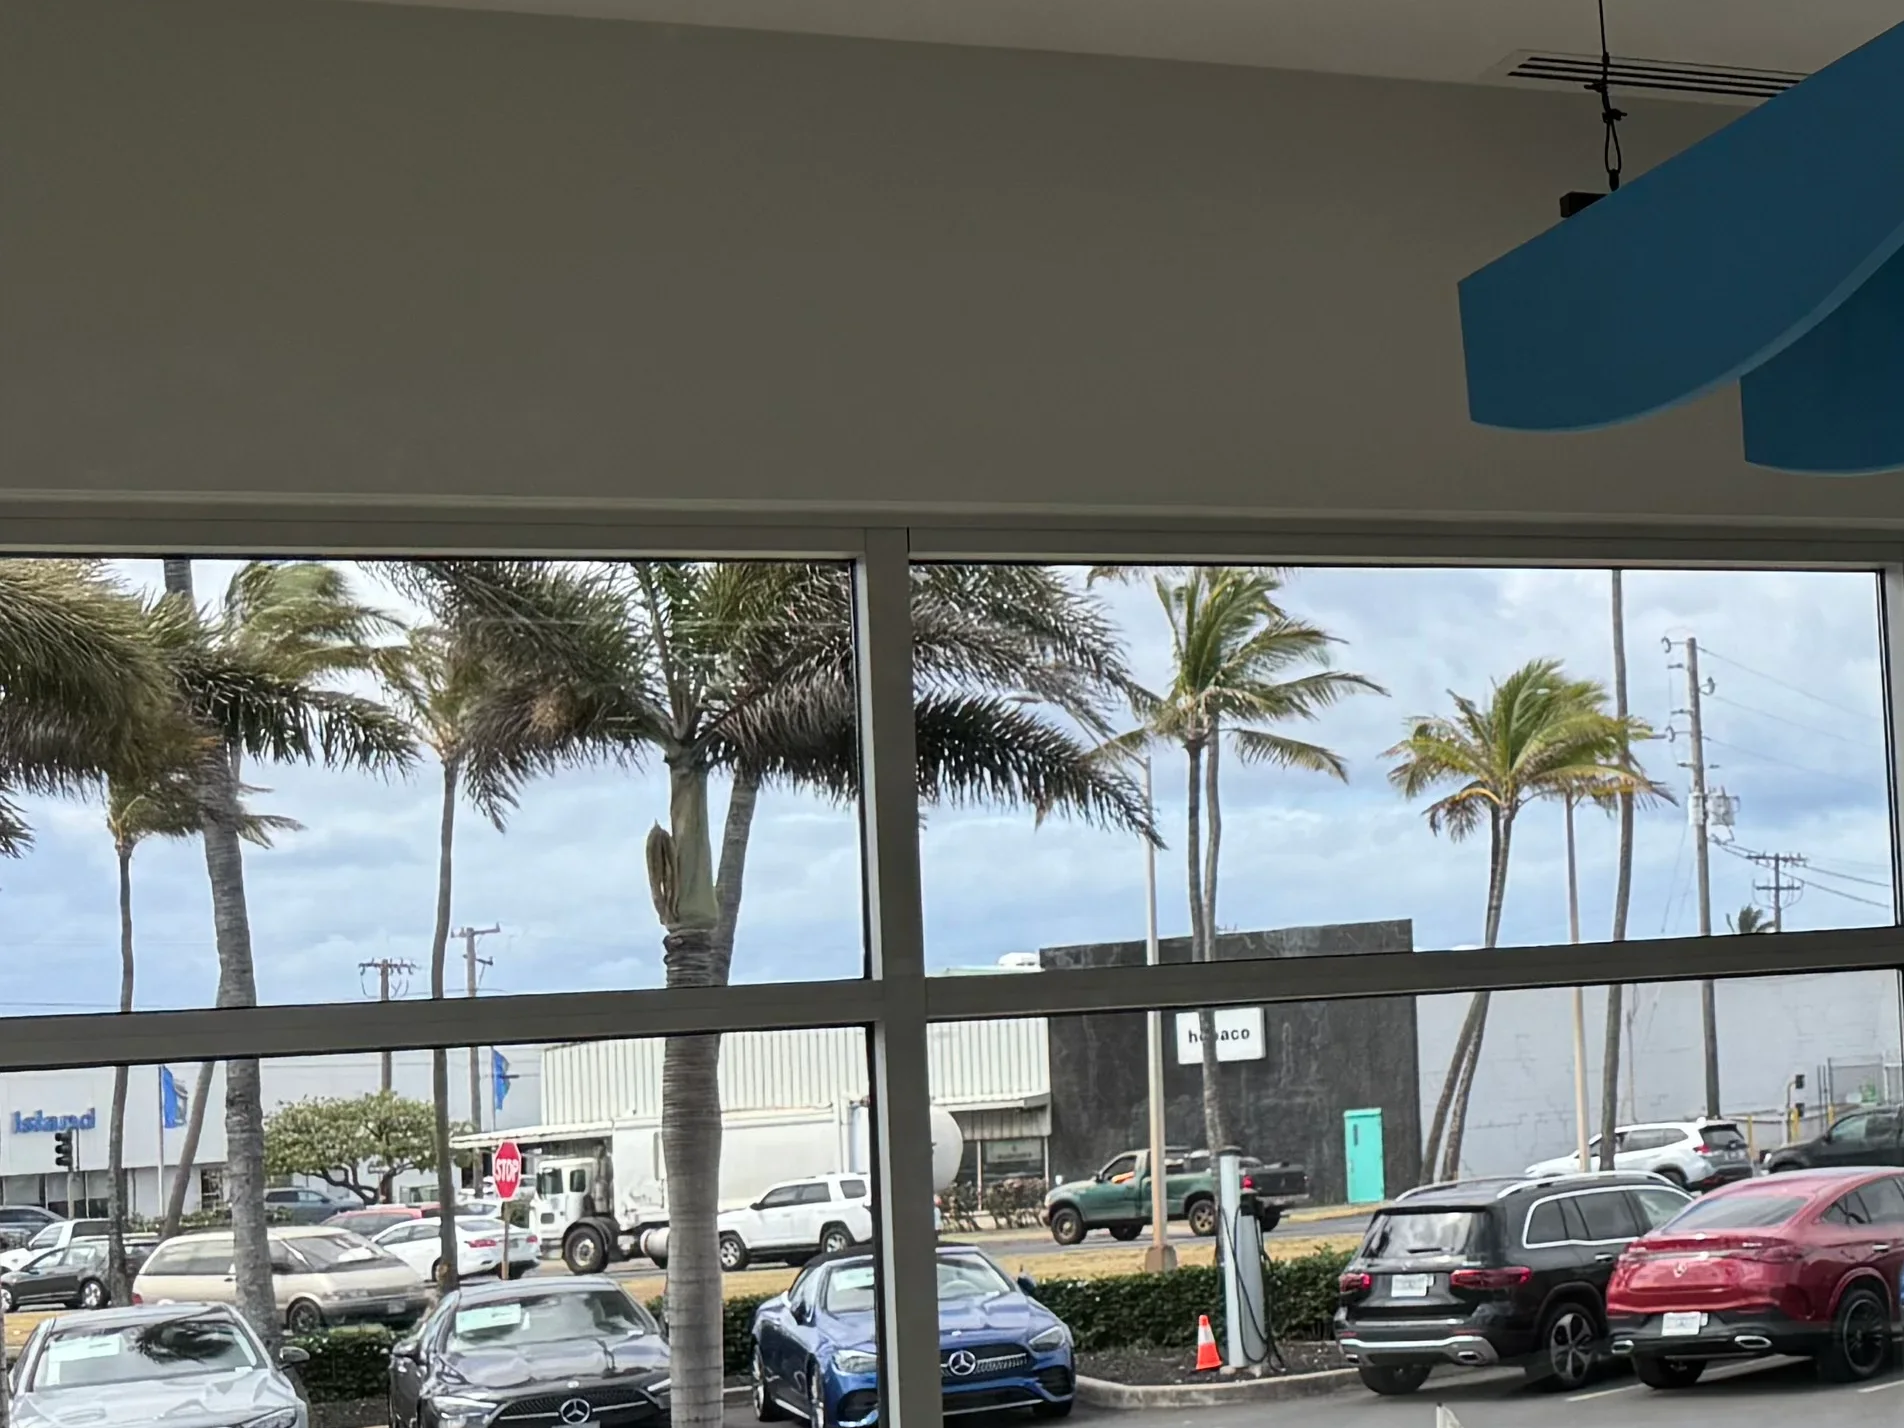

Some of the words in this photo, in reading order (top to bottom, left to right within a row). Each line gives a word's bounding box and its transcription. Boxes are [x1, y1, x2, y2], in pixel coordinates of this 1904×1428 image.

[1188, 1028, 1250, 1043] haco
[13, 1107, 96, 1133] Island
[495, 1158, 519, 1183] STOP
